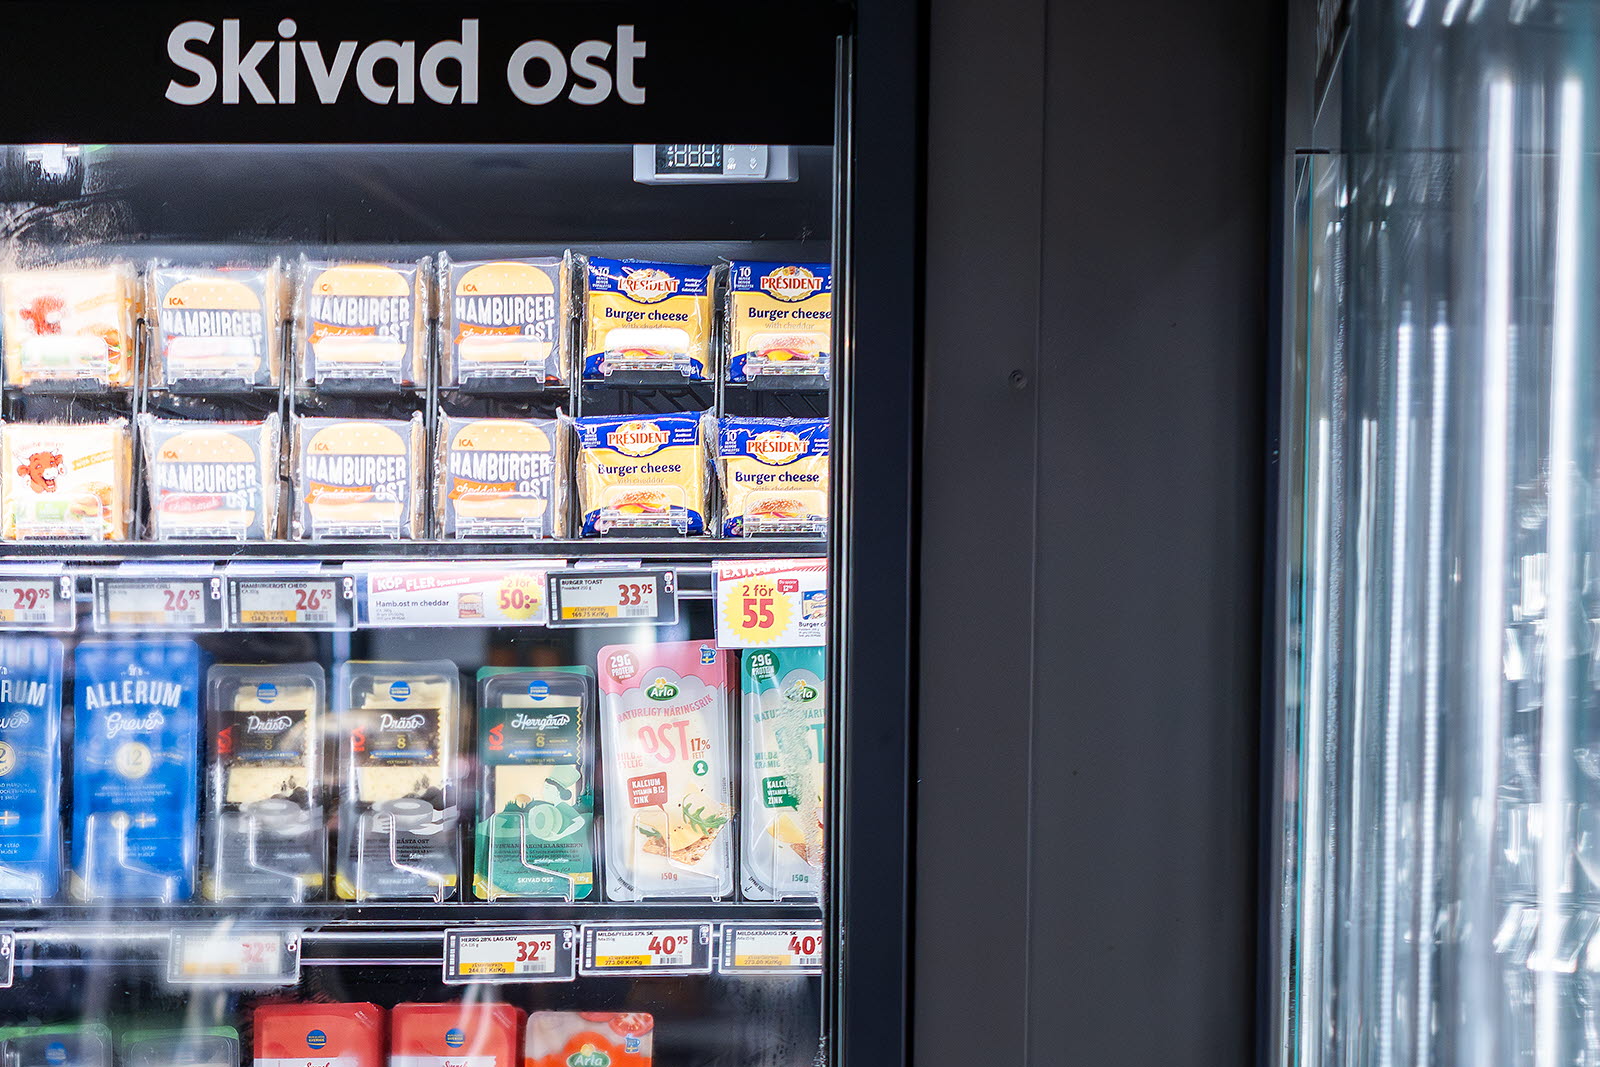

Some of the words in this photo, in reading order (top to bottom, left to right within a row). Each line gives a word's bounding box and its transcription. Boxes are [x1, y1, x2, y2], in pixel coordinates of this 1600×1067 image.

[164, 18, 480, 105] Skivad
[507, 24, 647, 106] ost
[739, 266, 751, 277] 10
[760, 275, 823, 291] PRÉSIDENT
[309, 295, 410, 327] HAMBURGER
[454, 295, 555, 326] HAMBURGER
[605, 307, 646, 323] Burger
[648, 308, 689, 322] cheese
[748, 307, 789, 323] Burger
[791, 307, 832, 319] cheese
[161, 308, 263, 337] HAMBURGER
[607, 429, 671, 447] PRÉSIDENT
[745, 439, 810, 455] PRÉSIDENT
[305, 455, 407, 486] HAMBURGER
[449, 452, 550, 482] HAMBURGER
[598, 462, 638, 477] Burger
[640, 461, 682, 474] cheese
[155, 464, 257, 491] HAMBURGER
[735, 471, 776, 487] Burger
[778, 471, 819, 483] cheese
[405, 576, 437, 590] FLER
[742, 585, 749, 596] 2
[754, 584, 774, 597] för
[741, 598, 775, 629] 55
[751, 653, 772, 668] 29G
[85, 680, 182, 711] ALLERUM
[650, 686, 674, 698] Arla
[380, 712, 425, 733] Präst
[511, 713, 571, 733] Herrgård
[638, 720, 691, 764] OST
[690, 737, 711, 752] 17%
[632, 777, 661, 790] KALCIUM
[633, 796, 649, 805] ZINK
[574, 1054, 603, 1067] Arla
